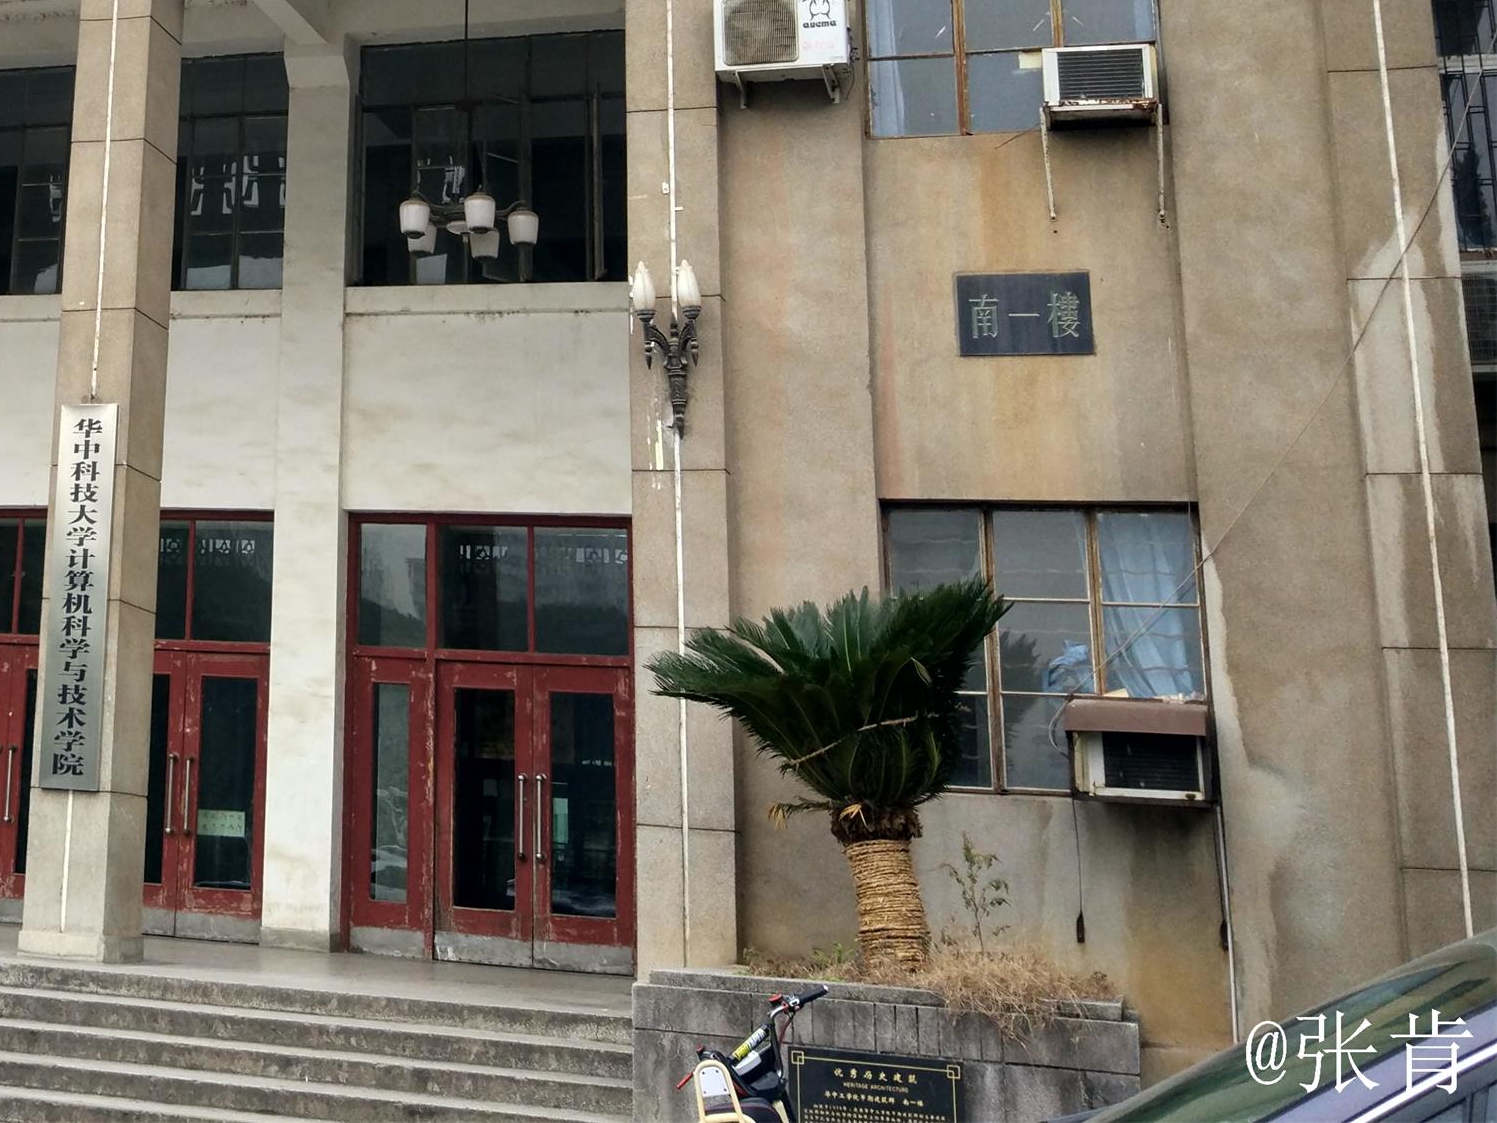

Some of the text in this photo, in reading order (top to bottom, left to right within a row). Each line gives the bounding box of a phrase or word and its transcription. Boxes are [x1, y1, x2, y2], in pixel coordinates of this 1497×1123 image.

[51, 417, 104, 777] 华中科技大学计算机科学与技术学院
